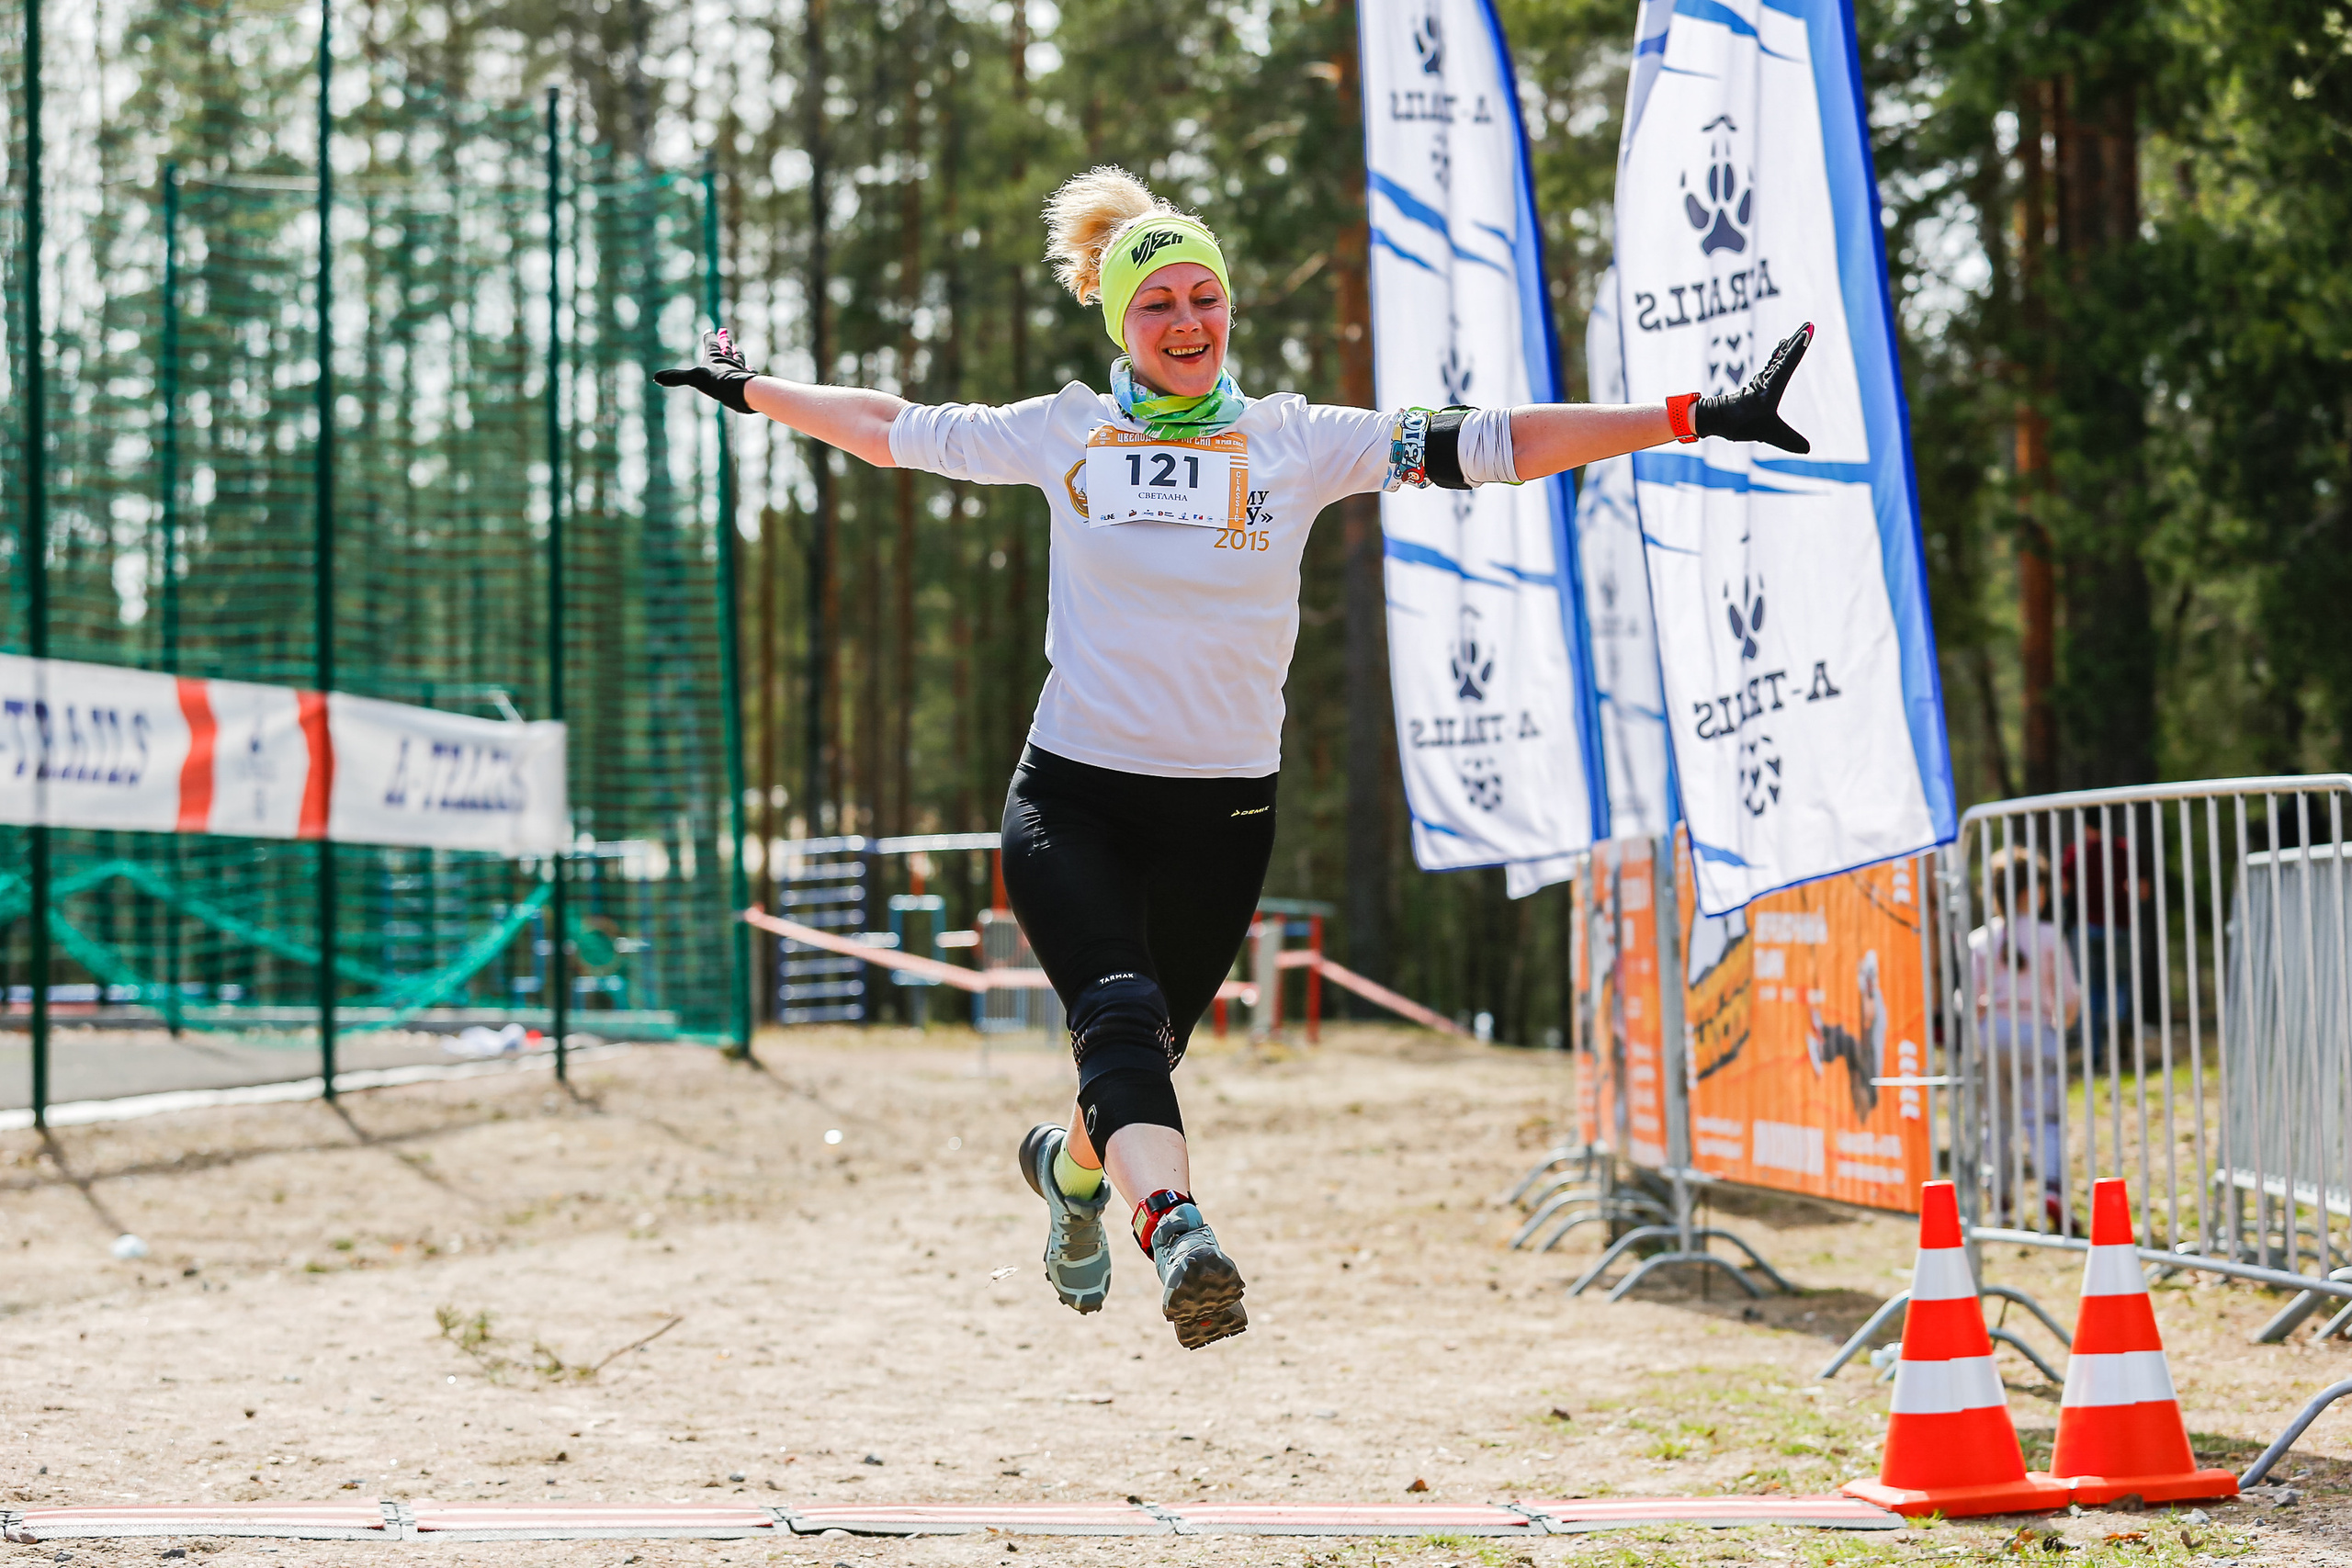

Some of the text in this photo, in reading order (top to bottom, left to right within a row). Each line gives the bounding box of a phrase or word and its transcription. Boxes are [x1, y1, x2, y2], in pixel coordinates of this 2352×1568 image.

[1125, 453, 1199, 489] 121
[1138, 491, 1188, 502] СВЕТЛАНА
[1214, 528, 1270, 551] 2015
[1099, 973, 1135, 985] TARMAK
